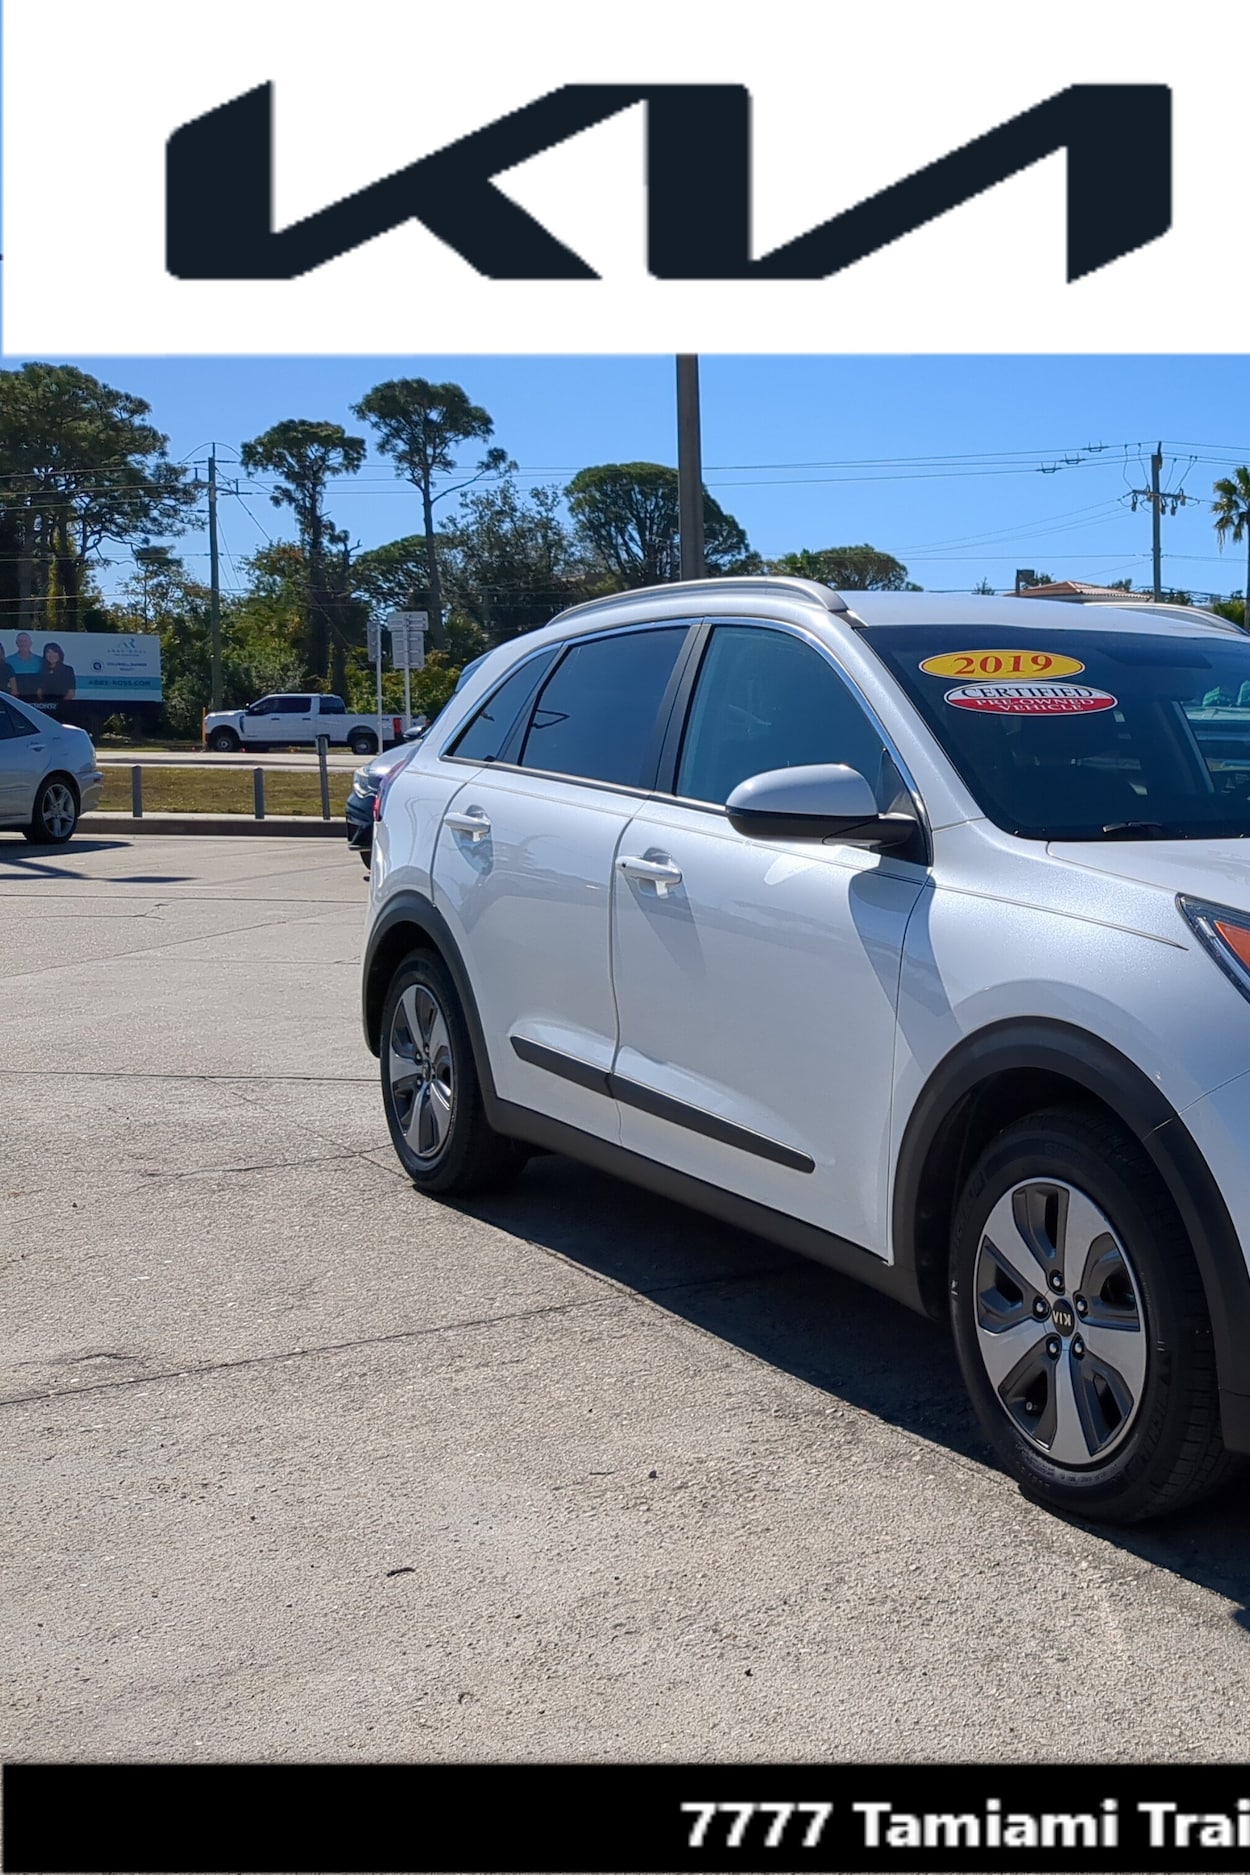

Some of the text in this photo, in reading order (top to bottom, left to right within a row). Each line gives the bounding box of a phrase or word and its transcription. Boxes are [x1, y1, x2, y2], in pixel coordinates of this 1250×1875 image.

[953, 655, 1053, 675] 2019
[961, 687, 1093, 698] CERTIFIED
[976, 698, 1095, 706] PRE-OWNED
